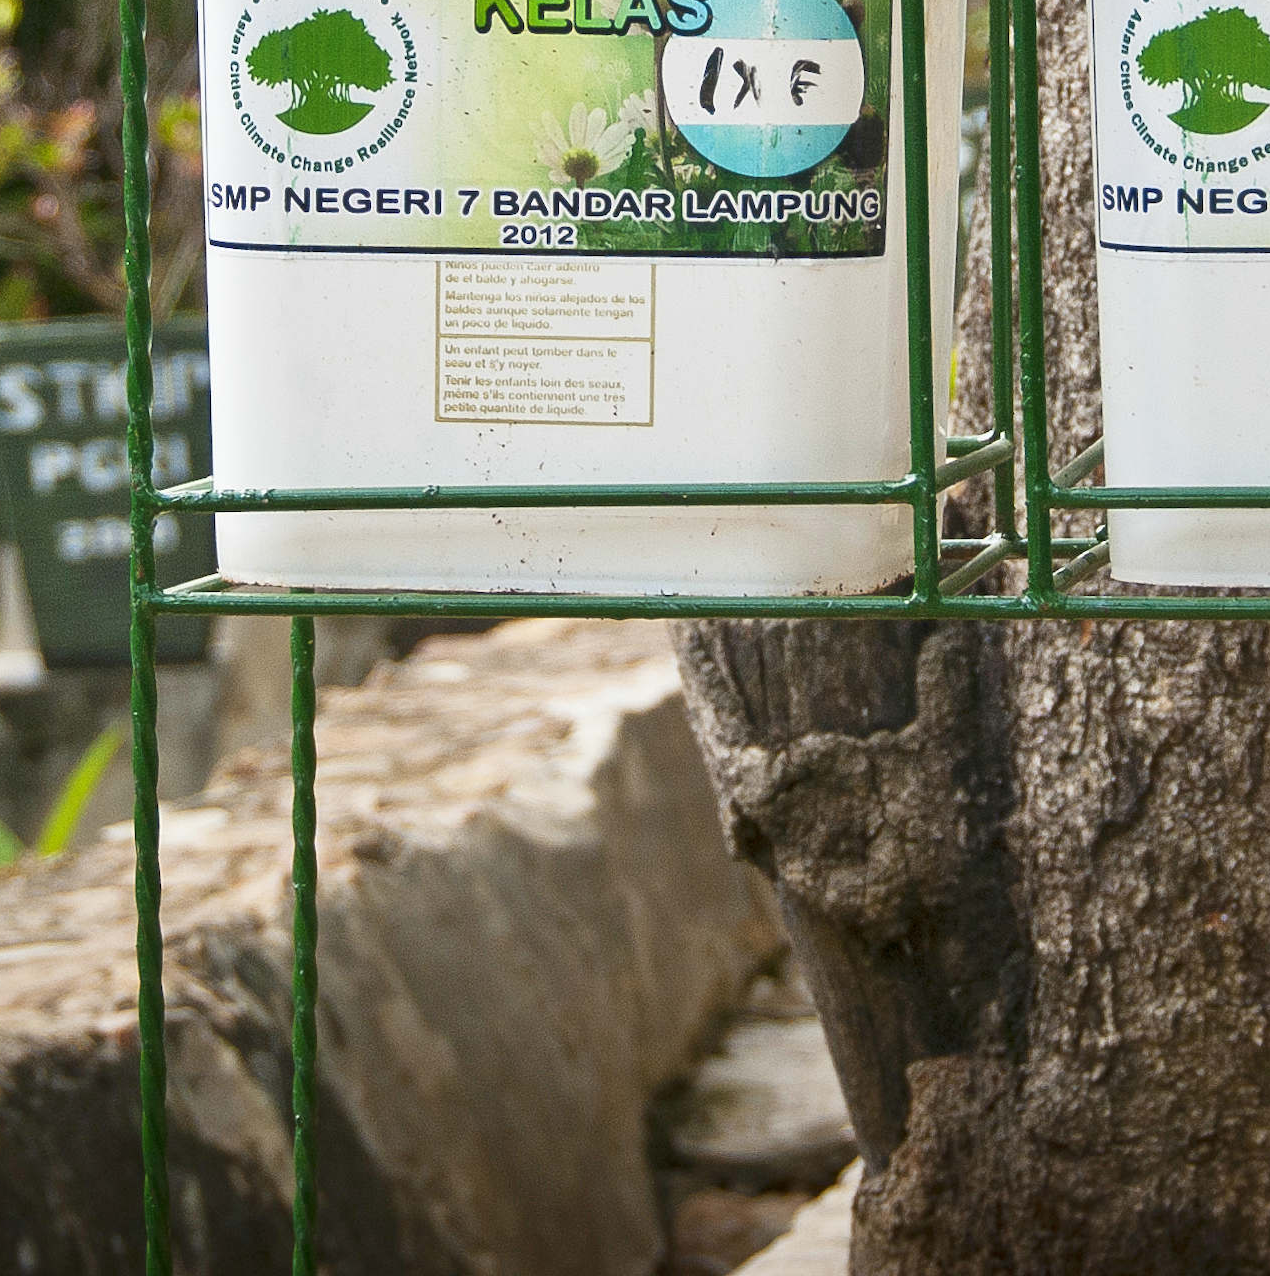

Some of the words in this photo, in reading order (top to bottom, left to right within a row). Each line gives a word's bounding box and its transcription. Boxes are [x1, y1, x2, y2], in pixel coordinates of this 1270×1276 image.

[231, 8, 252, 55] Asian
[1120, 8, 1142, 55] Asian
[391, 12, 418, 83] Network
[230, 61, 243, 110] Cities
[1120, 60, 1134, 111] Cities
[357, 88, 417, 163] Resilience
[240, 113, 286, 164] Climate
[1131, 113, 1178, 165] Climate
[291, 155, 354, 174] Change
[1183, 155, 1249, 174] Change
[209, 183, 270, 213] SMP
[284, 187, 443, 217] NEGERI
[457, 190, 478, 217] 7
[493, 189, 674, 219] BANDAR
[682, 189, 881, 222] LAMPUNG
[1102, 184, 1164, 214] SMP
[501, 224, 576, 246] 2012
[445, 275, 459, 283] de
[463, 274, 472, 283] el
[476, 275, 507, 284] balde
[510, 277, 516, 286] y
[445, 290, 502, 303] Mantenga
[505, 291, 522, 302] los
[560, 293, 608, 306] alejados
[611, 294, 626, 304] de
[628, 295, 646, 304] los
[445, 304, 482, 314] baldes
[486, 306, 528, 317] aunque
[531, 306, 591, 317] solamente
[595, 308, 634, 320] tengan
[445, 319, 459, 328] un
[462, 319, 491, 330] poco
[494, 319, 508, 328] de
[445, 344, 460, 354] Un
[464, 345, 499, 355] enfant
[503, 346, 528, 357] peut
[532, 347, 573, 357] tomber
[577, 348, 605, 358] dans
[607, 348, 617, 357] le
[445, 359, 472, 368] seau
[475, 359, 486, 368] et
[445, 374, 472, 385] Tenir
[475, 376, 491, 386] les
[495, 376, 537, 387] enfants
[540, 377, 561, 388] loin
[564, 378, 585, 388] des
[508, 390, 576, 401] contiennent
[579, 393, 600, 402] une
[444, 401, 477, 413] petite
[530, 404, 544, 414] de
